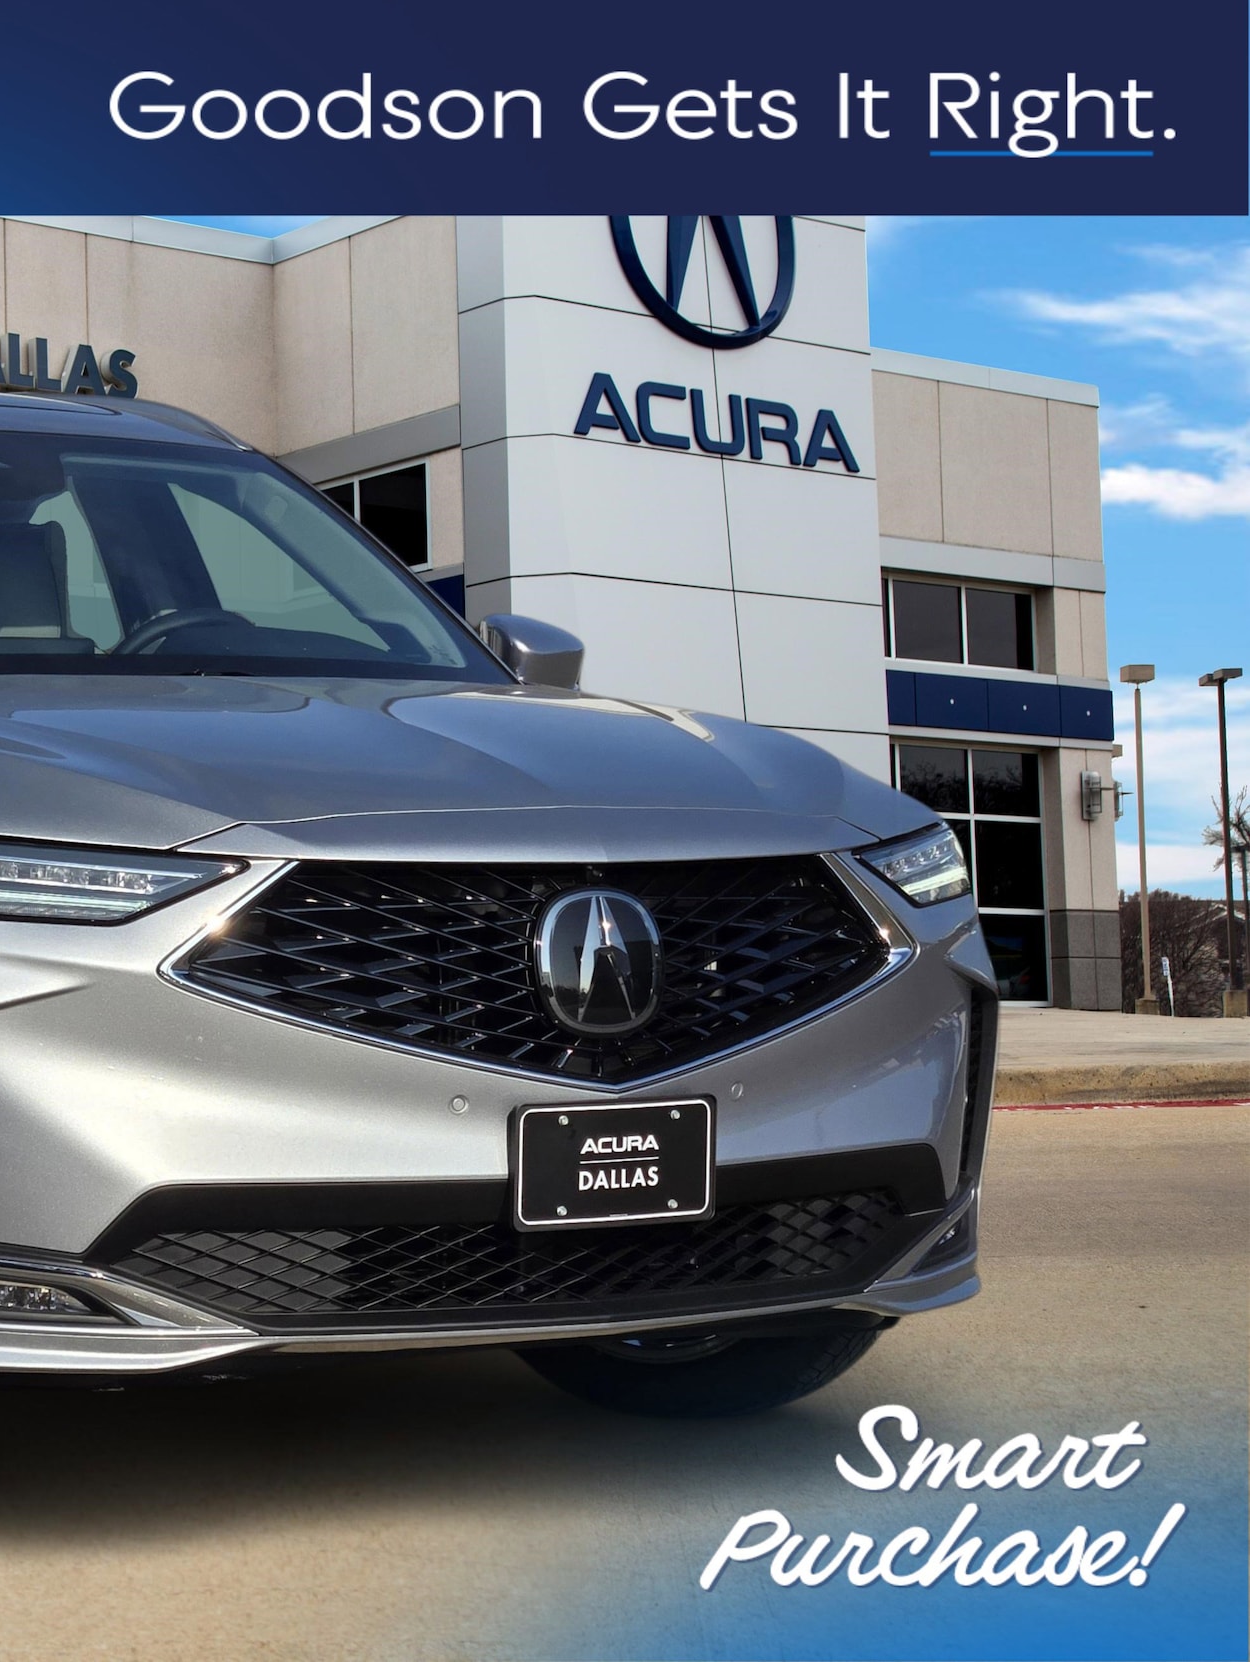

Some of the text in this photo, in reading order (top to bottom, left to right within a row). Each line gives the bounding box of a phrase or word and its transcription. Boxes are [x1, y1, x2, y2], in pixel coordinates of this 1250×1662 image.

[573, 371, 860, 473] ACURA
[580, 1134, 660, 1155] ACURA
[578, 1166, 659, 1191] DALLAS
